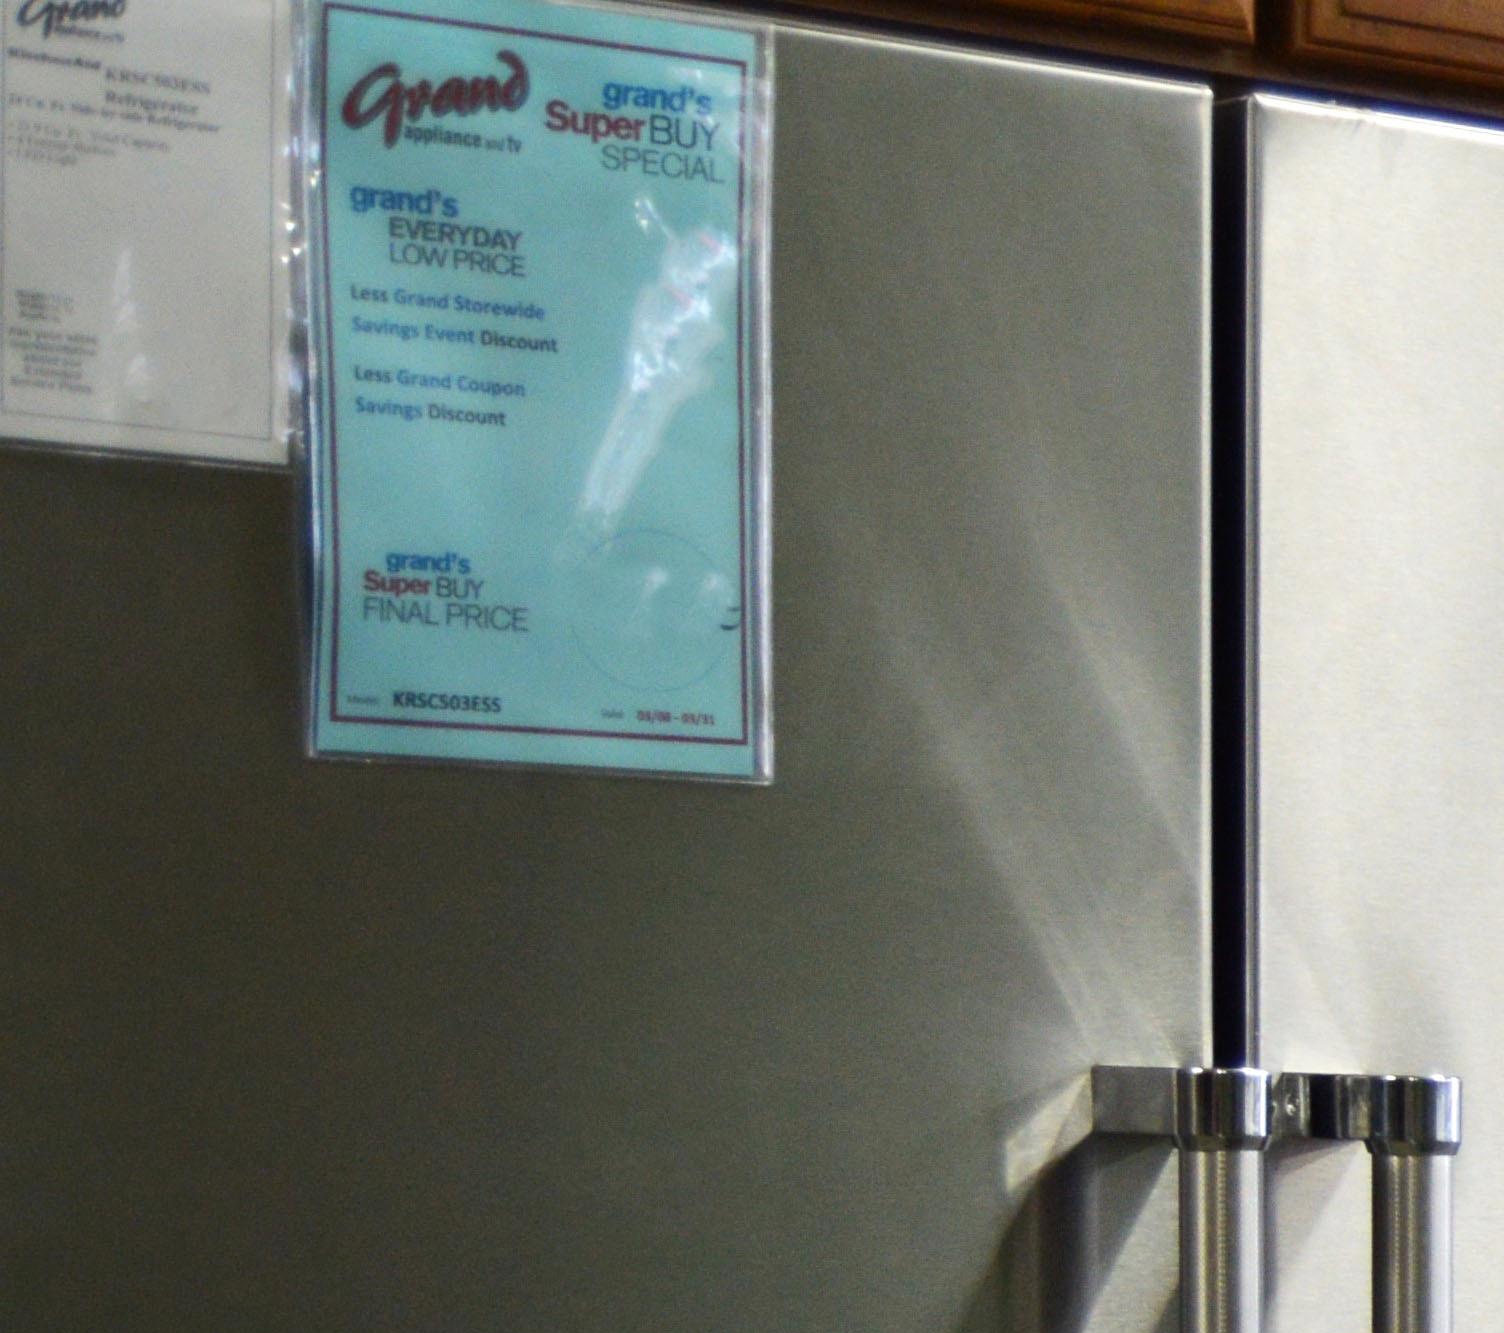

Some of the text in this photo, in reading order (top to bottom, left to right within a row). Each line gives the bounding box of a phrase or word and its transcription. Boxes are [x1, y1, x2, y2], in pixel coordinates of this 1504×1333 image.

[341, 50, 530, 149] Grand
[603, 81, 712, 116] grand's
[404, 125, 482, 149] appliance
[545, 100, 645, 143] Super
[600, 145, 725, 184] SPECIAL
[350, 184, 459, 217] grand's
[389, 217, 522, 252] EVERYDAY
[389, 242, 526, 277] LOW PRICE
[350, 284, 546, 321] Less Grand Storewide
[351, 316, 558, 353] Savings Event Discount
[354, 364, 526, 400] Less Grand Coupon
[355, 396, 507, 427] Savings Discount
[386, 550, 472, 575] grand's
[363, 570, 485, 600] Super BUY
[362, 596, 529, 633] FINAL PRICE
